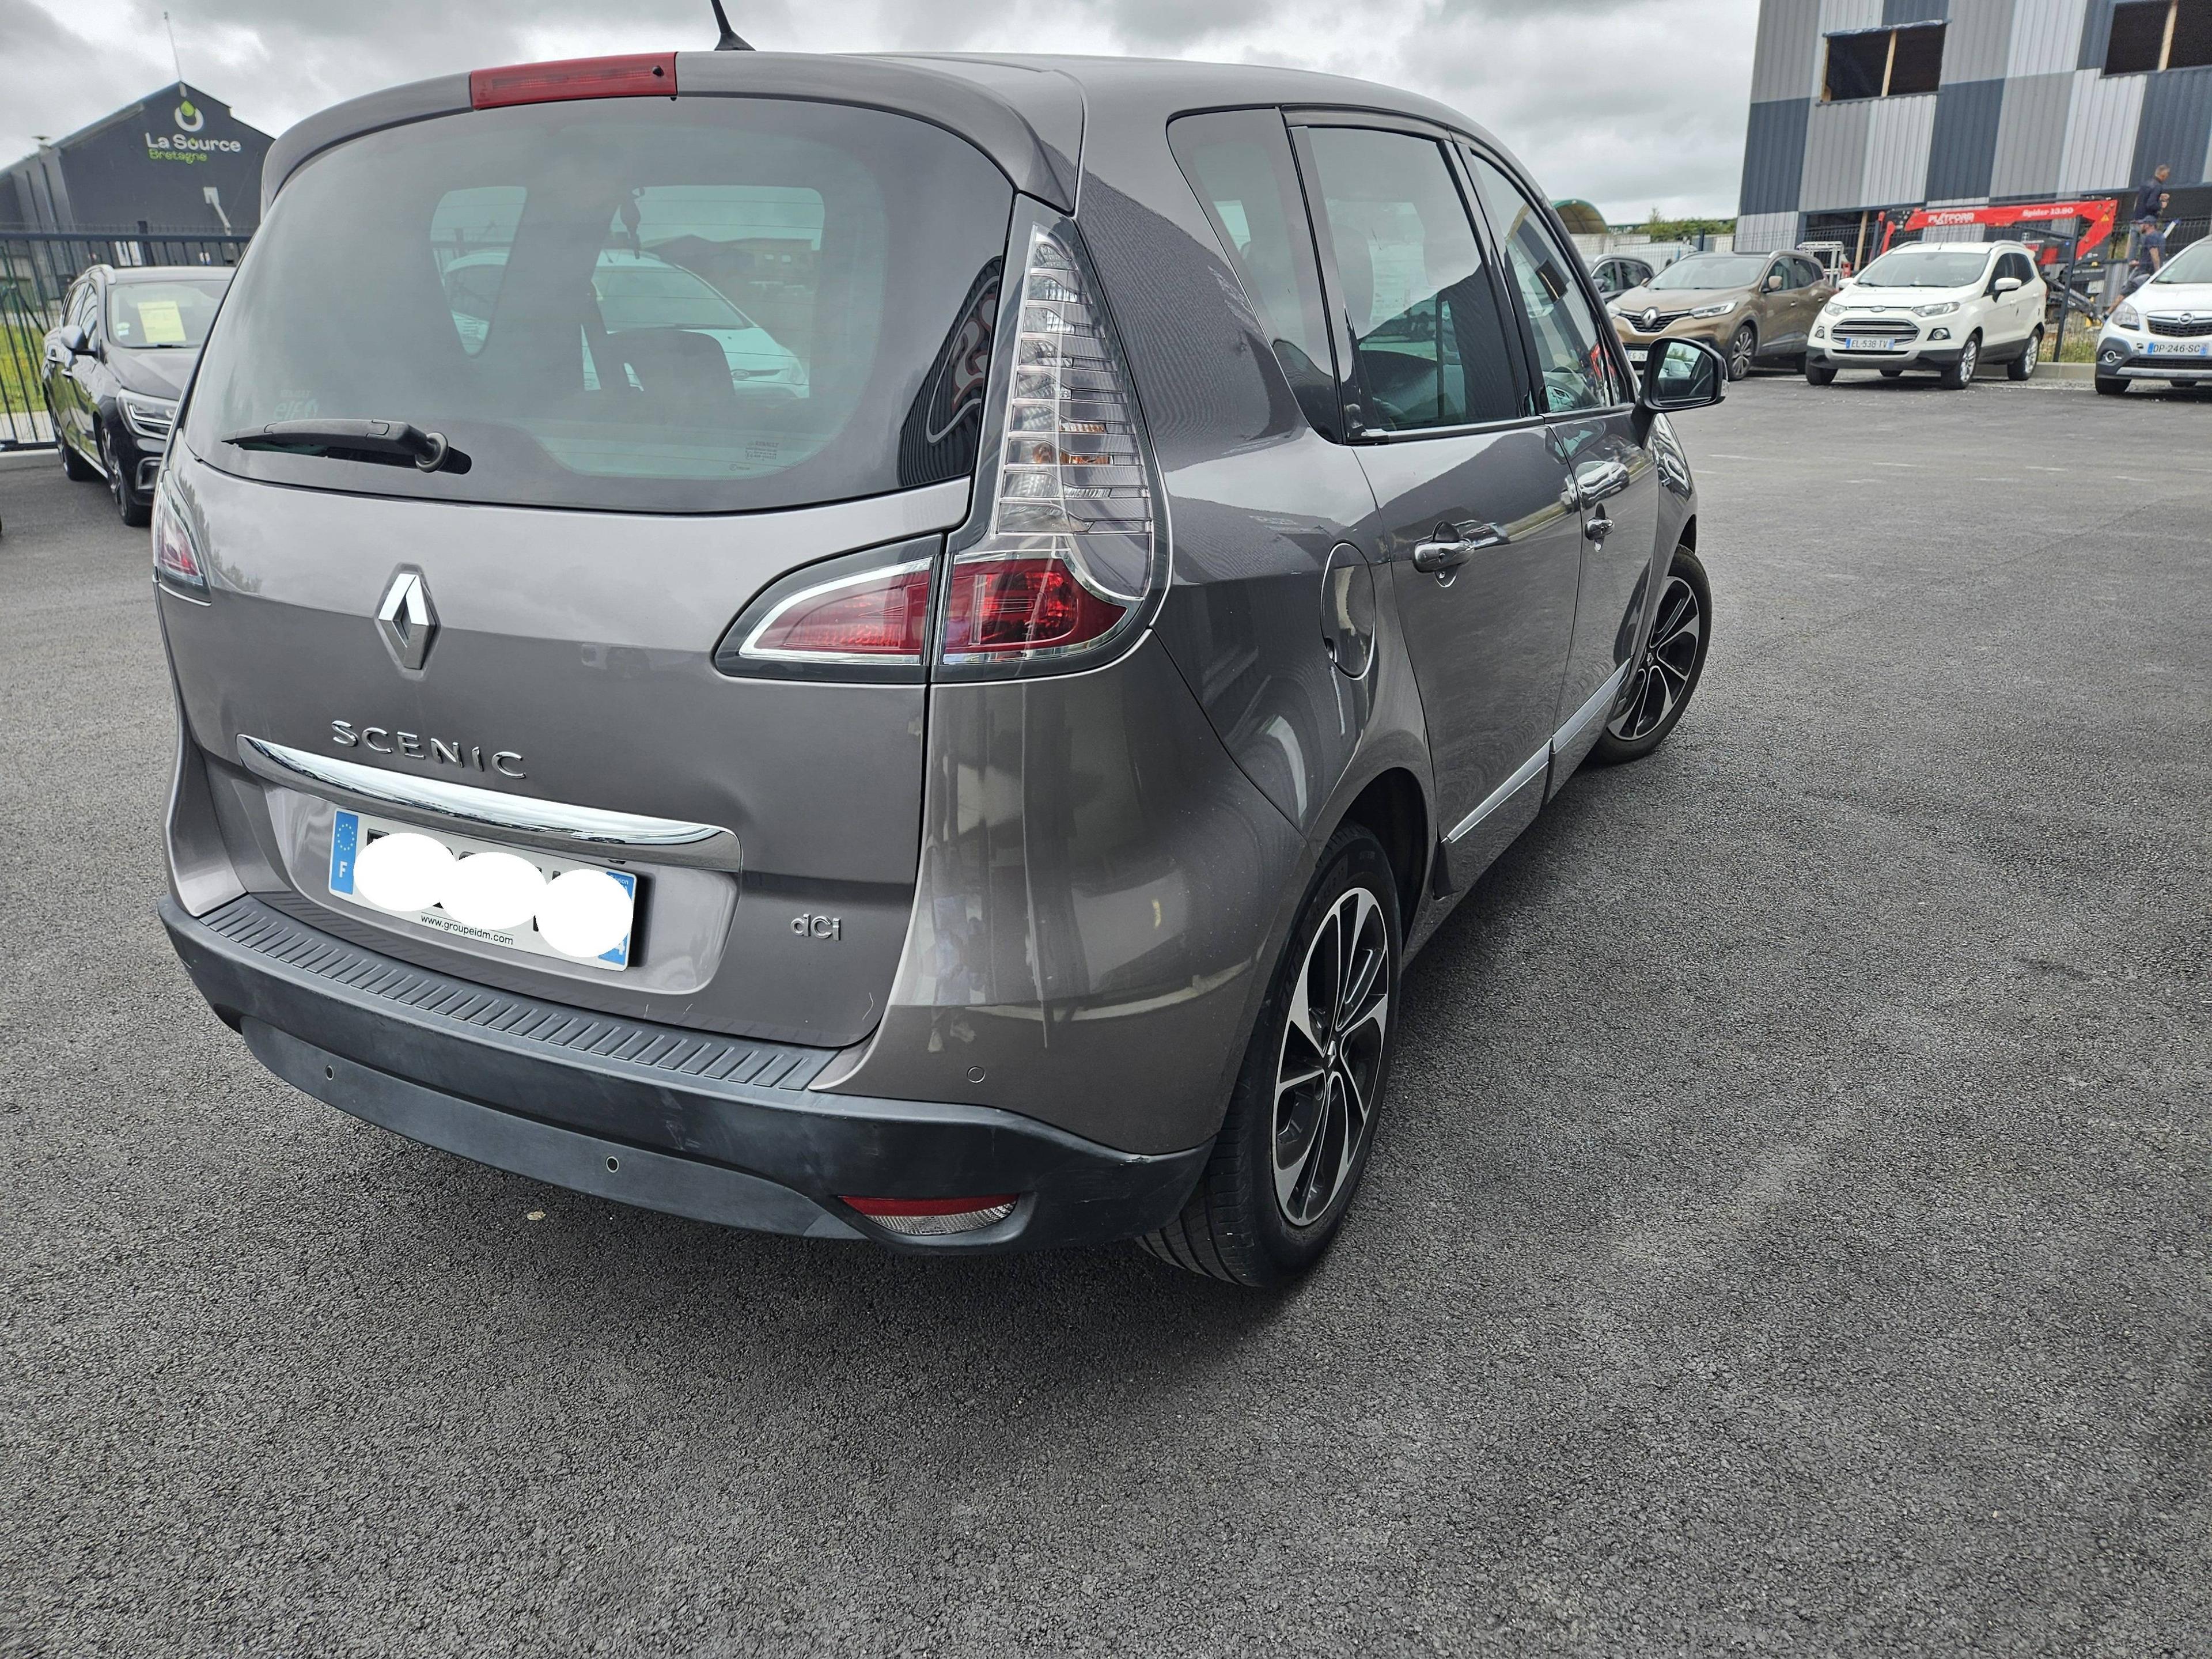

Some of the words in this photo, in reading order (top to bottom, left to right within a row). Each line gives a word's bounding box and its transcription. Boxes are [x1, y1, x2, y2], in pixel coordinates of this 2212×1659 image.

[145, 132, 170, 149] La
[173, 134, 241, 152] Source
[149, 149, 208, 164] Bretagne
[2022, 209, 2050, 218] Spider
[331, 719, 527, 779] SCENIC
[339, 860, 348, 878] F
[421, 915, 513, 945] www.groupeidm.com
[790, 913, 841, 941] dCi
